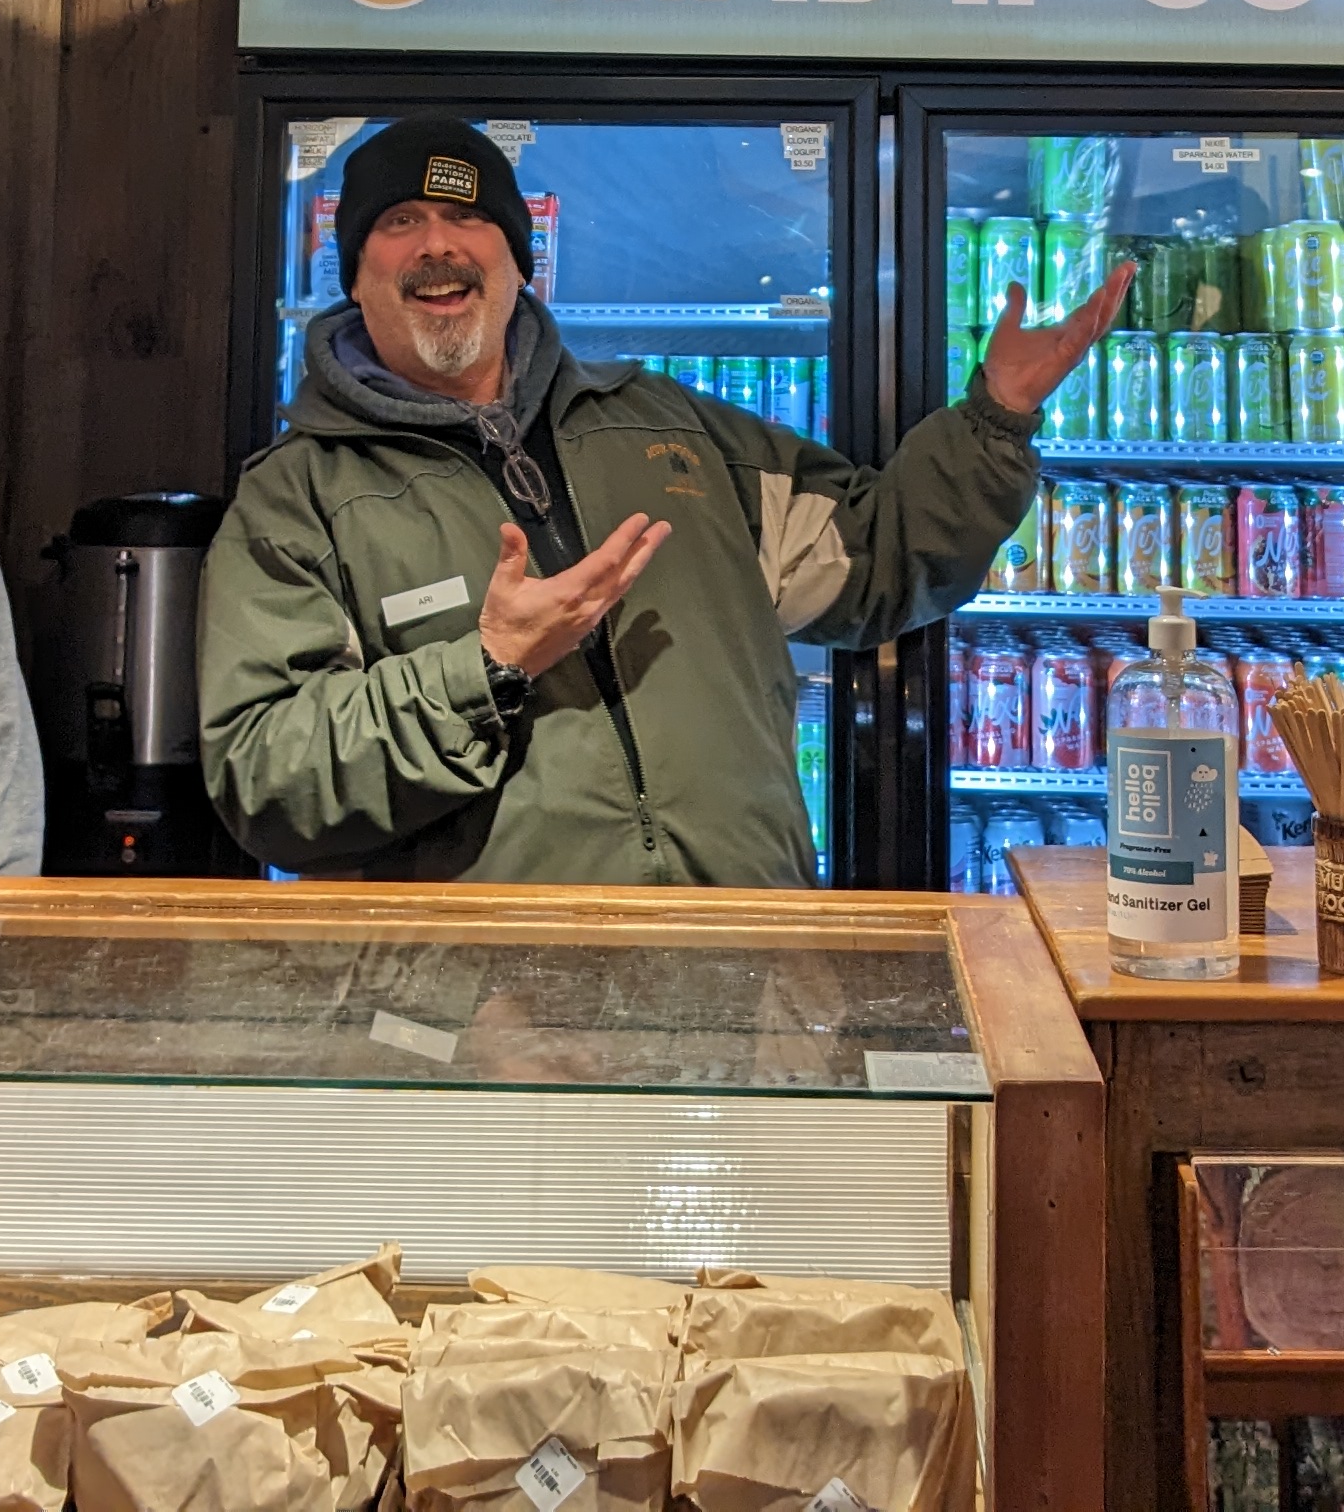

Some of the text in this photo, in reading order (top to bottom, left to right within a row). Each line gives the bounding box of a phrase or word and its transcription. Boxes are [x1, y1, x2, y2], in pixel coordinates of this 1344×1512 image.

[491, 123, 527, 131] HORIZON
[785, 125, 822, 134] ORGANIC
[491, 134, 532, 142] HOCOLATE
[787, 137, 819, 145] CLOVER
[1204, 140, 1226, 148] NIXIE
[788, 148, 821, 156] YOGURT
[1178, 151, 1254, 159] SPARKLING WATER
[793, 159, 814, 168] $3.50
[1204, 162, 1225, 170] $4.00
[431, 168, 474, 182] NATIONAL
[431, 175, 472, 189] PARKS
[775, 309, 802, 317] APPLE
[418, 595, 434, 606] ARI
[1124, 763, 1141, 822] hello
[1142, 764, 1161, 823] bello
[1119, 841, 1172, 854] Fragrance-Free
[1122, 865, 1167, 878] 70% Alcohol
[1107, 892, 1211, 911] and Sanitizer Gel
